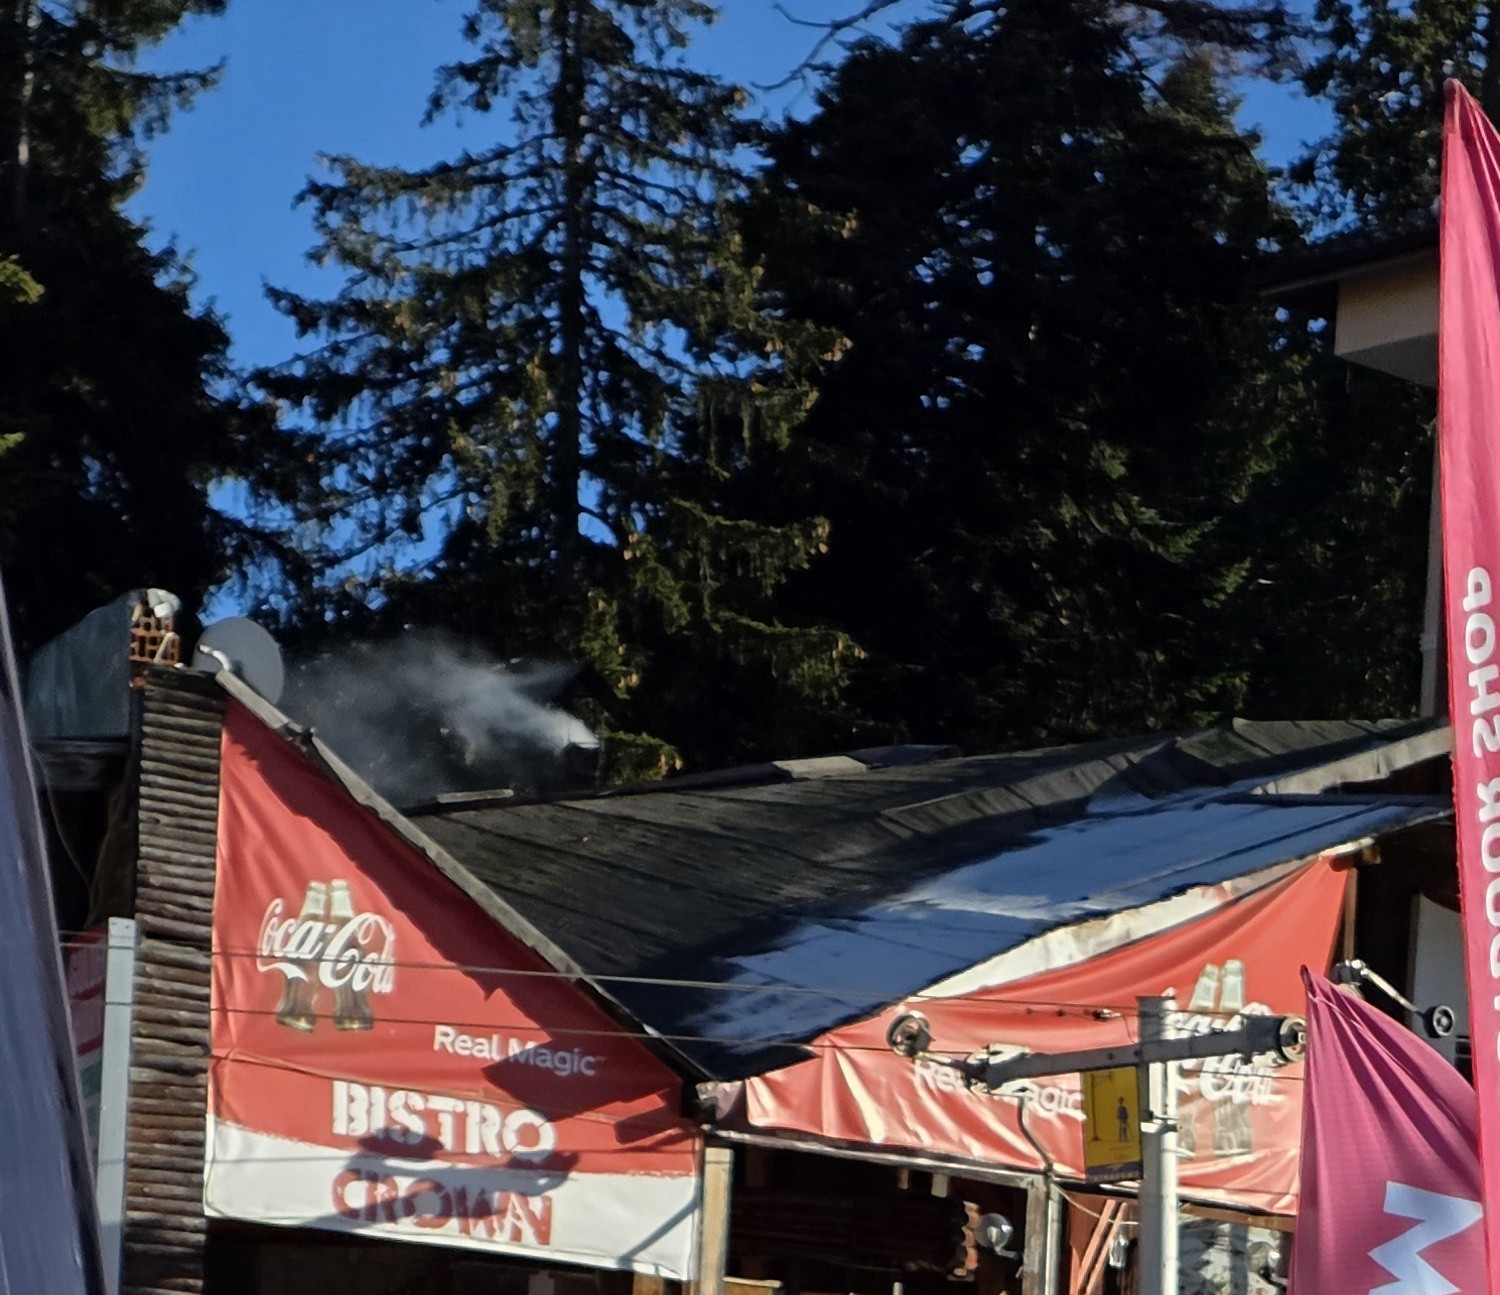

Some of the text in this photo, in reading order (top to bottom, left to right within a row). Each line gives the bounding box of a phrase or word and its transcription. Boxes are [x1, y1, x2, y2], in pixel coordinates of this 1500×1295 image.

[257, 898, 396, 993] Coca-Cola
[434, 1025, 597, 1077] Real Magic
[331, 1079, 556, 1165] BISTRO
[331, 1168, 552, 1246] CROWN
